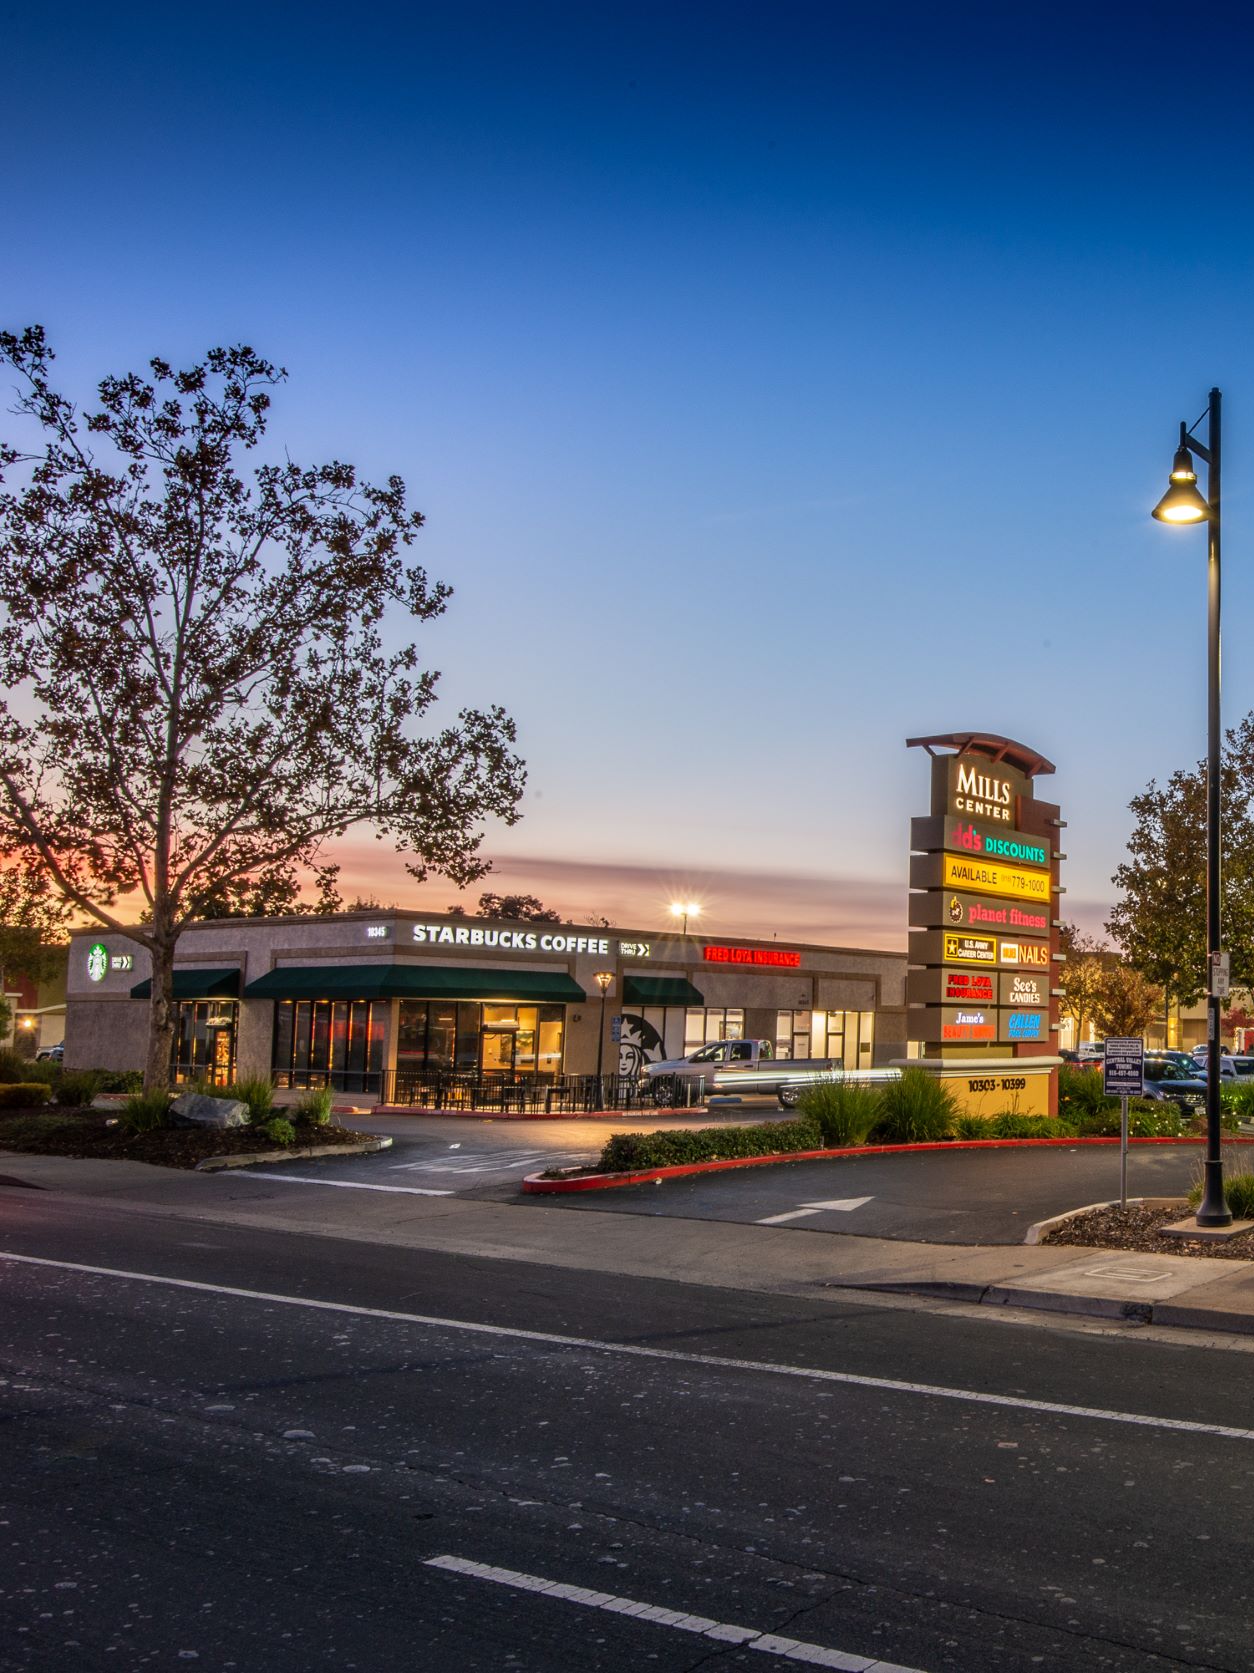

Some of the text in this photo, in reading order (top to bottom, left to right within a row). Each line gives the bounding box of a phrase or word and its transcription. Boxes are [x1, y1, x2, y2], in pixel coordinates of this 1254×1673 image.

[956, 764, 1010, 805] MILLS
[956, 798, 1010, 820] CENTER
[985, 837, 1045, 863] DISCOUNTS
[951, 865, 997, 885] AVAILABLE
[968, 903, 1047, 929] planet fitness
[412, 924, 609, 955] STARBUCKS COFFEE
[620, 942, 637, 950] DRIVE
[964, 939, 989, 950] U.S. ARMY
[705, 946, 800, 967] FRED LOYA INSURANCE
[958, 949, 976, 959] CAREER
[976, 950, 994, 960] CENTER
[1019, 945, 1048, 965] NAILS
[948, 974, 992, 988] FRED LOYA
[1013, 976, 1037, 993] See's
[946, 986, 993, 999] INSURANCE
[1009, 992, 1040, 1003] CANDIES
